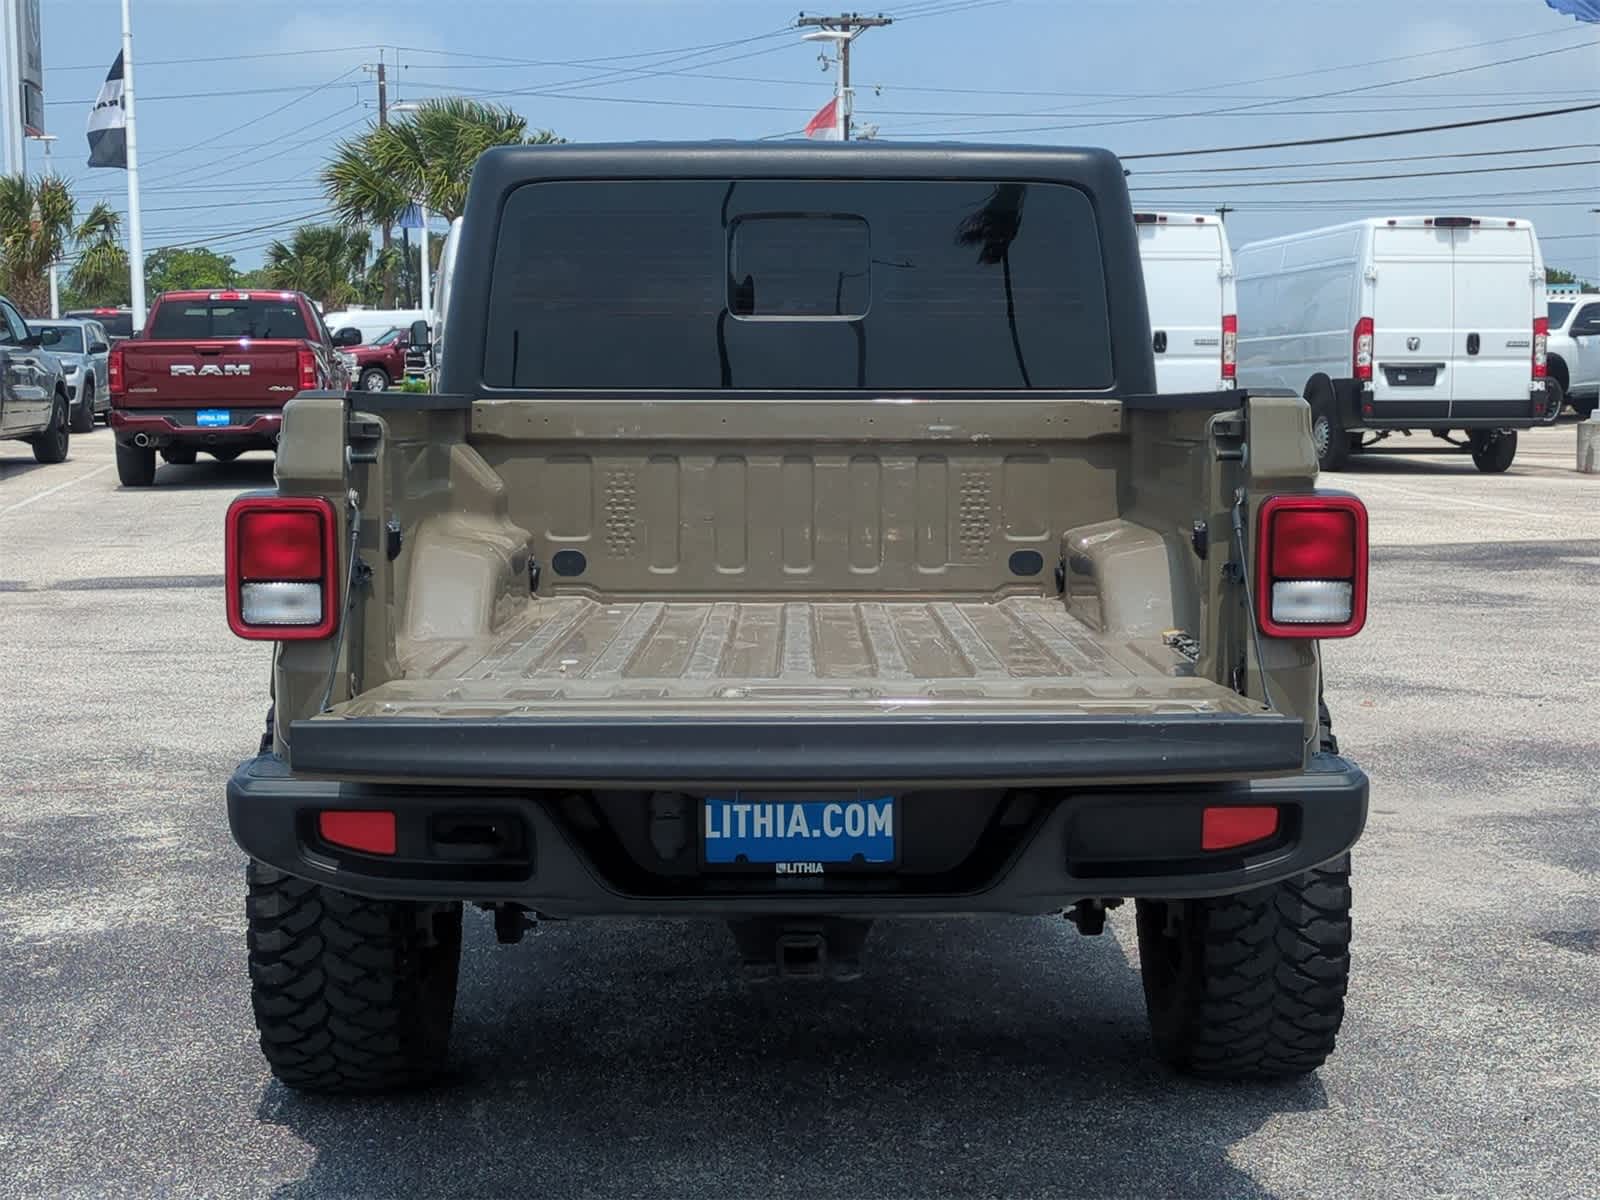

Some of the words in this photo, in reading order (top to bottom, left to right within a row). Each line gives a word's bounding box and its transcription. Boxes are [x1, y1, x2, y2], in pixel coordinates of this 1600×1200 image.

[170, 364, 251, 376] RAM
[705, 803, 893, 838] LITHIA.COM
[787, 863, 824, 874] LITHIA
